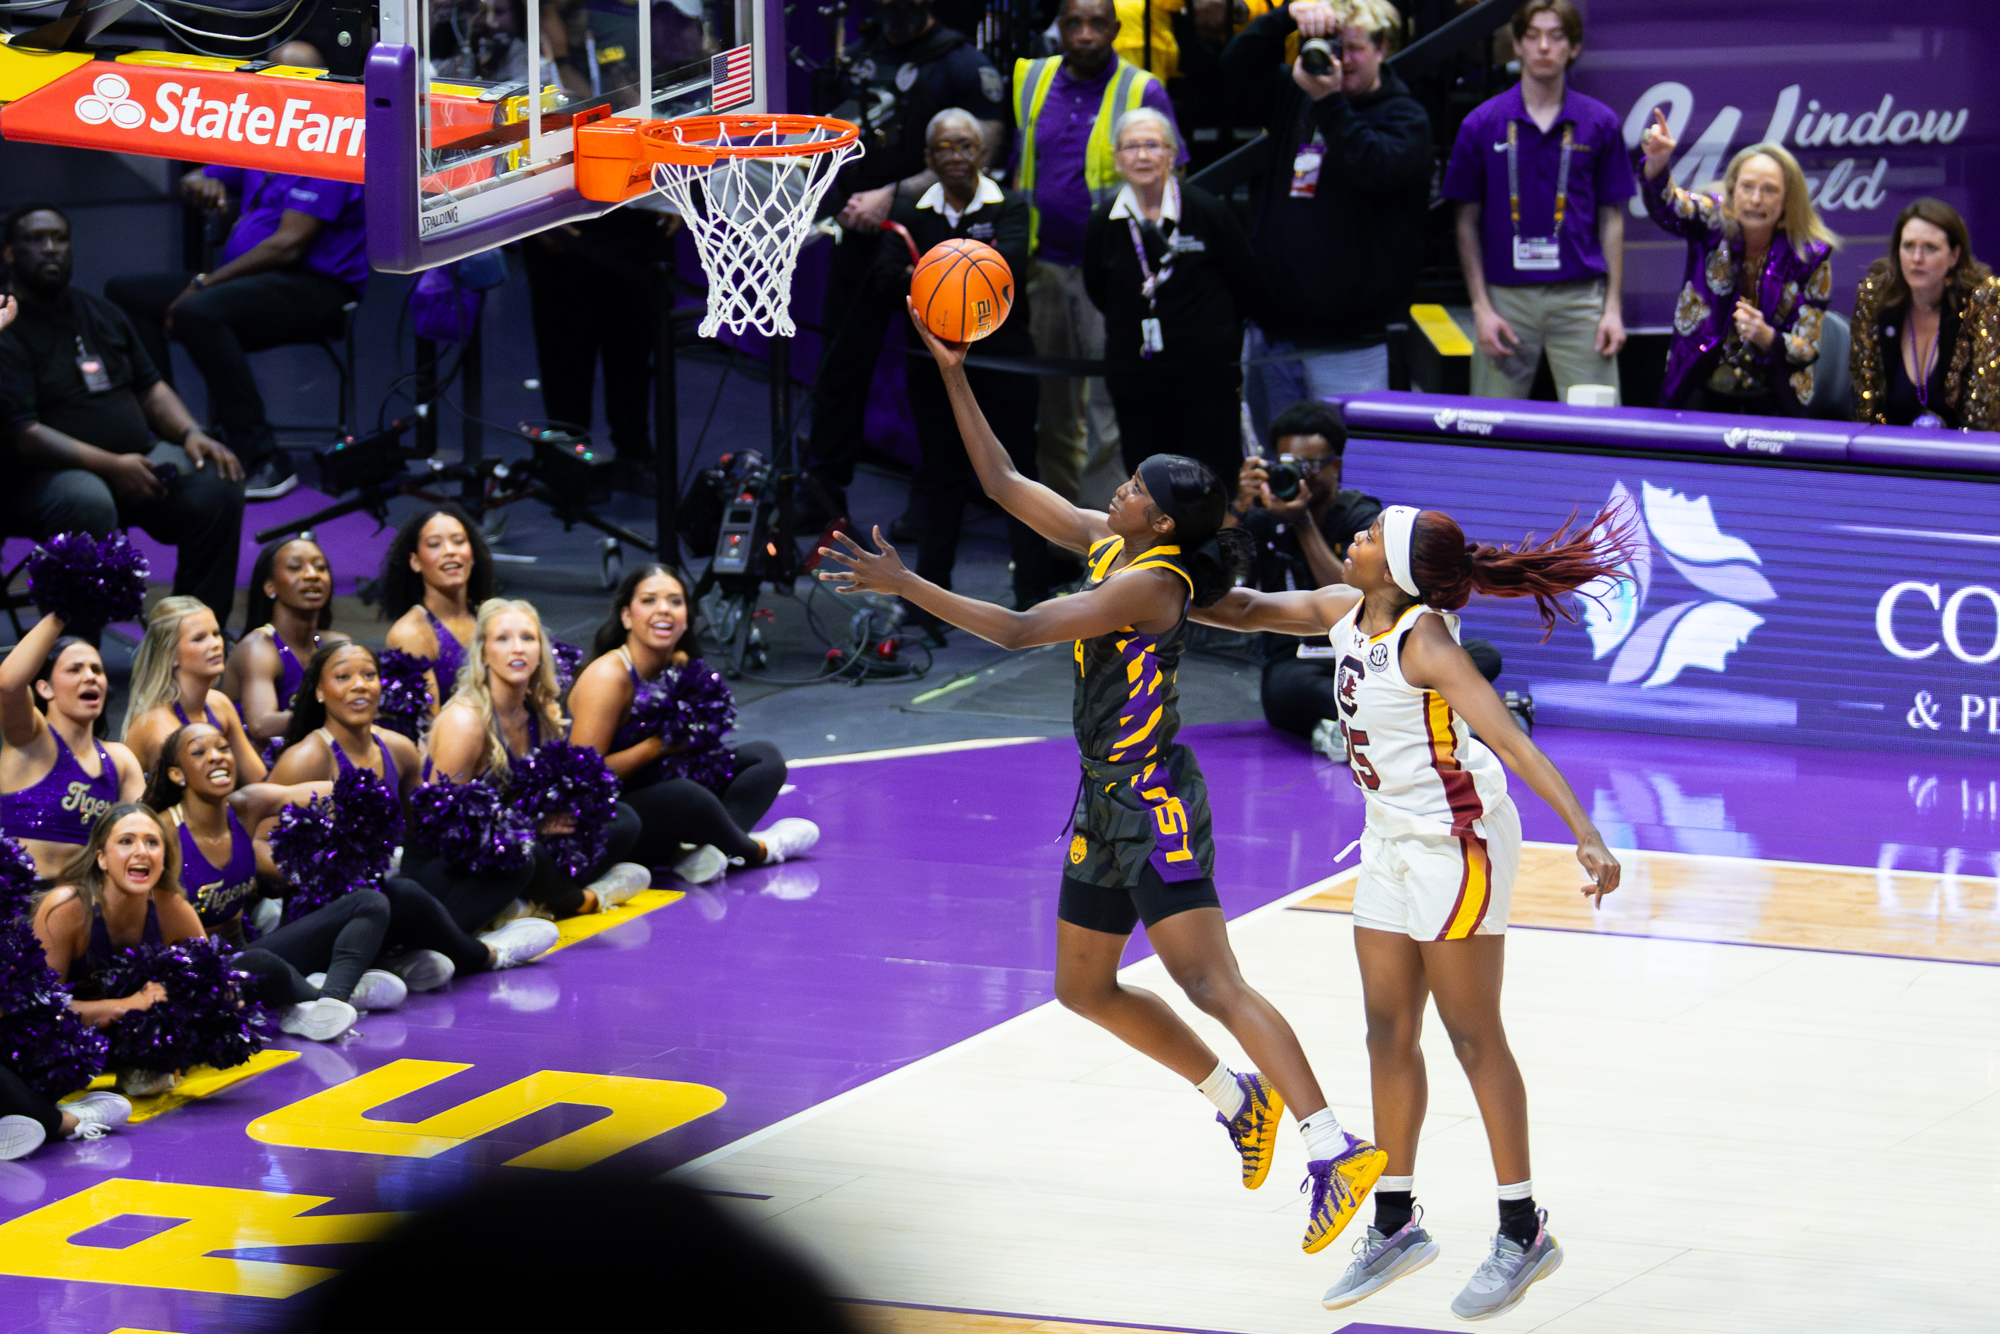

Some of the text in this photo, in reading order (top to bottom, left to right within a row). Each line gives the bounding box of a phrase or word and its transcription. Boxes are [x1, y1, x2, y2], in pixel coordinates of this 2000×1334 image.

[421, 205, 459, 235] SPALDING
[1457, 419, 1493, 435] Energy
[1747, 437, 1783, 454] Energy
